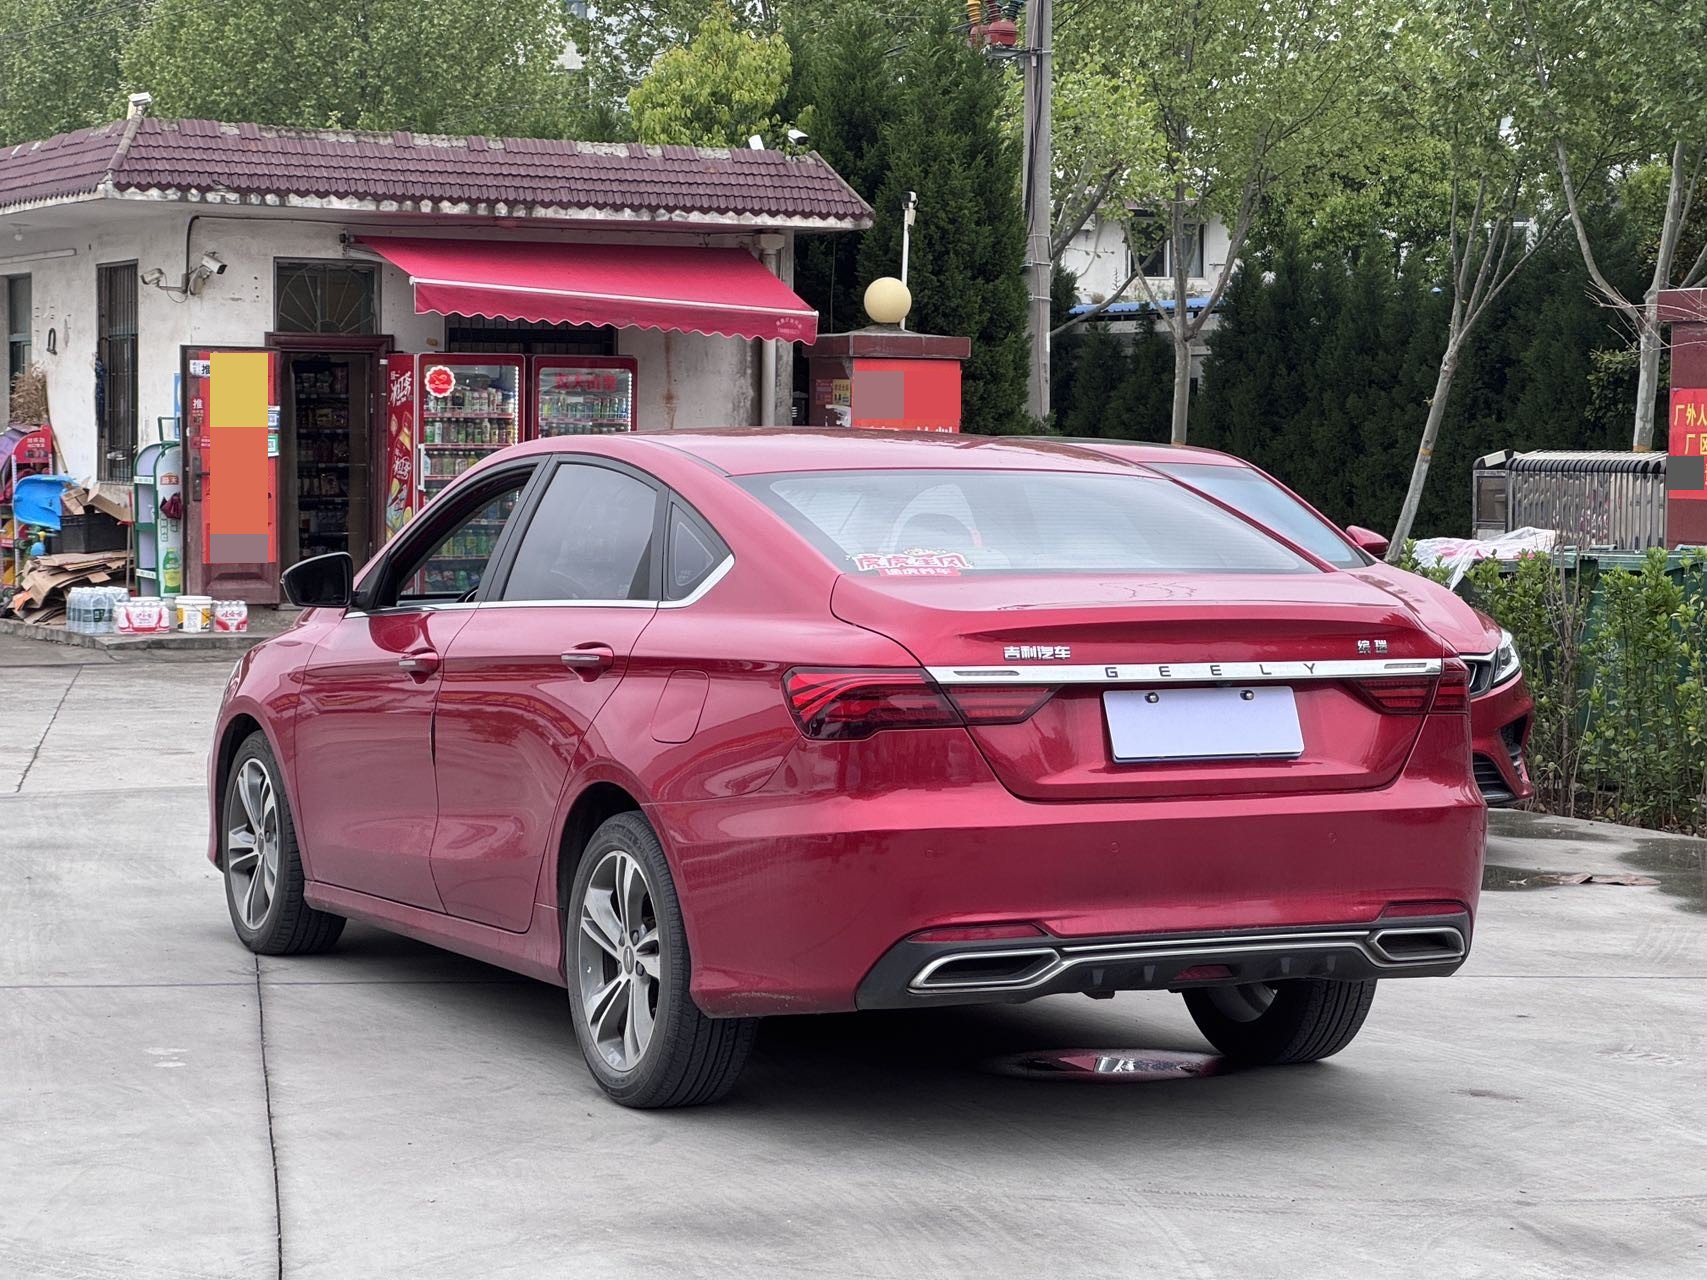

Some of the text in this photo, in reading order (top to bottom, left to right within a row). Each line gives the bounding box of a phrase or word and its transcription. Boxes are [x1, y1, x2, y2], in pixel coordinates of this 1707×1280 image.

[1003, 645, 1071, 660] 吉利汽车
[1105, 663, 1316, 678] GEELY
